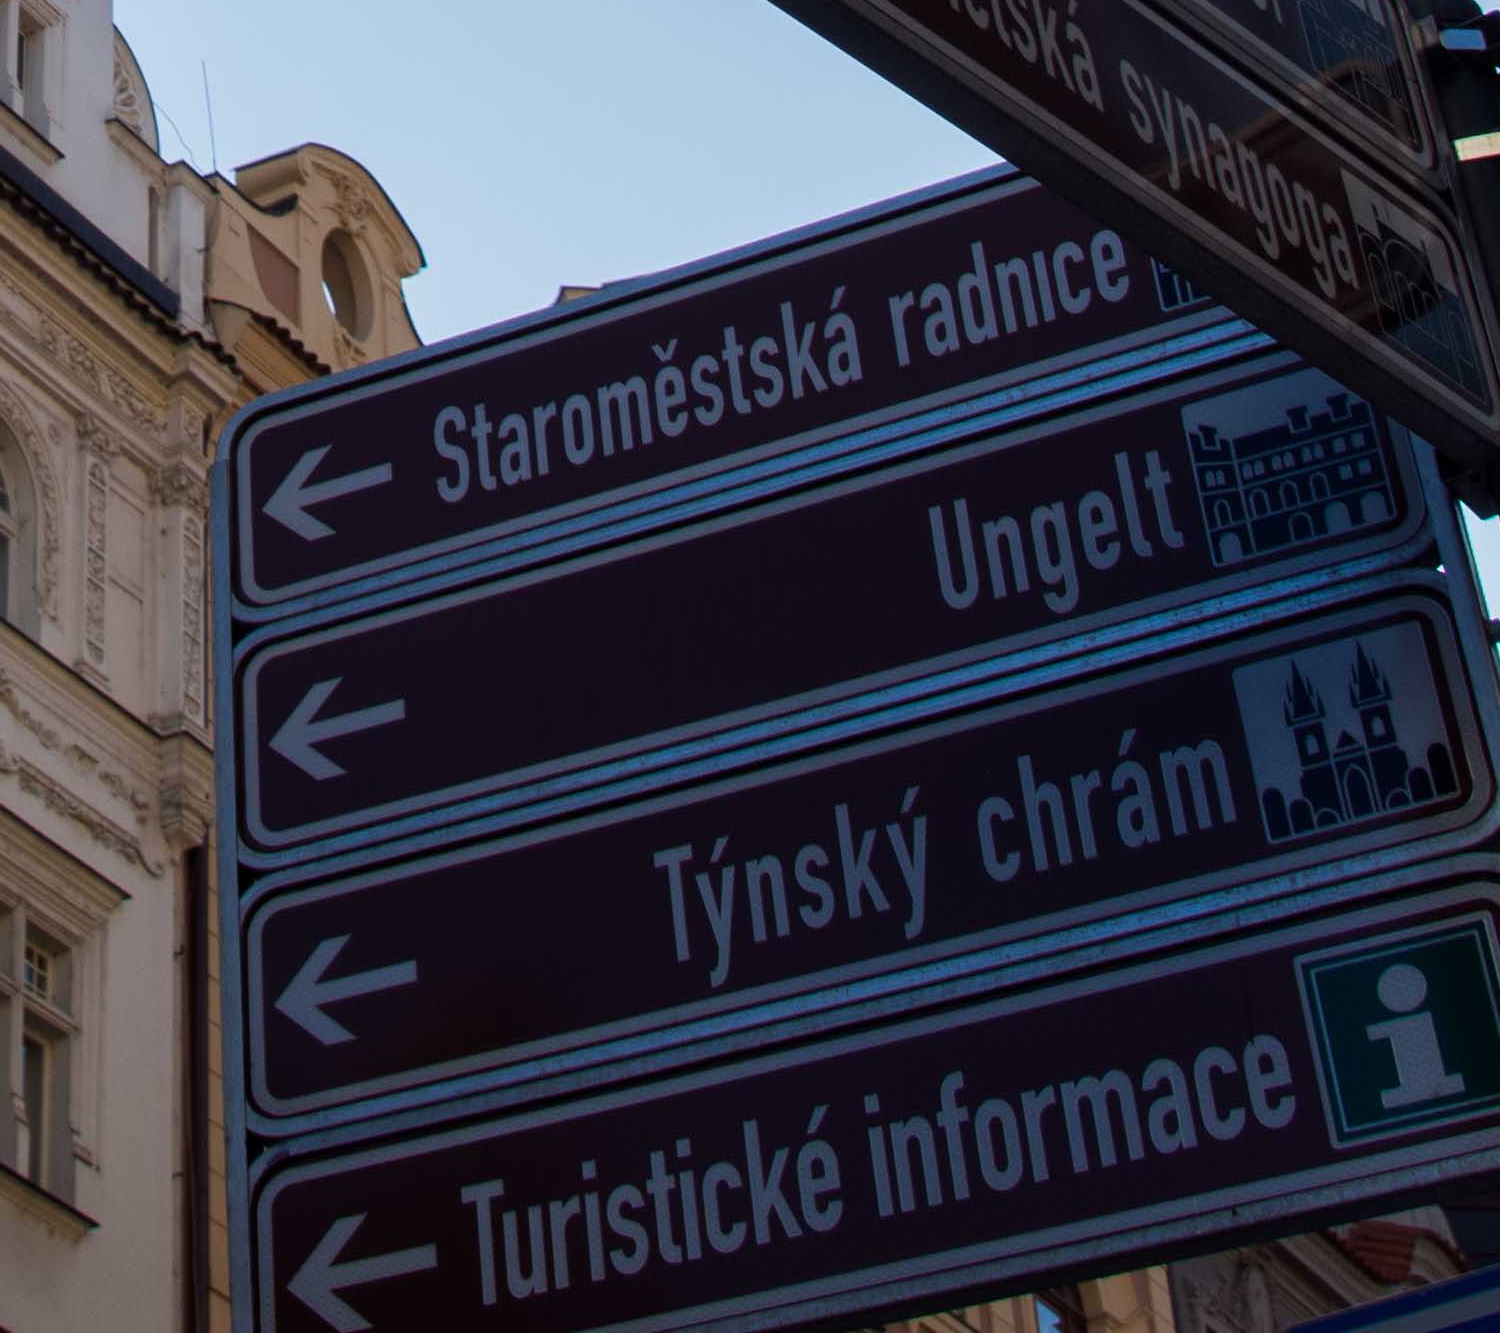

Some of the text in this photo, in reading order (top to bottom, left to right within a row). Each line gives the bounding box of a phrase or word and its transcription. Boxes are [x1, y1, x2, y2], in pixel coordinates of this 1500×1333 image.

[1120, 57, 1359, 299] synagoga
[432, 286, 863, 504] Staroměstská
[927, 449, 1184, 613] Ungelt
[652, 728, 1239, 985] Týnský chrám
[461, 1032, 1297, 1307] Turistické informace
